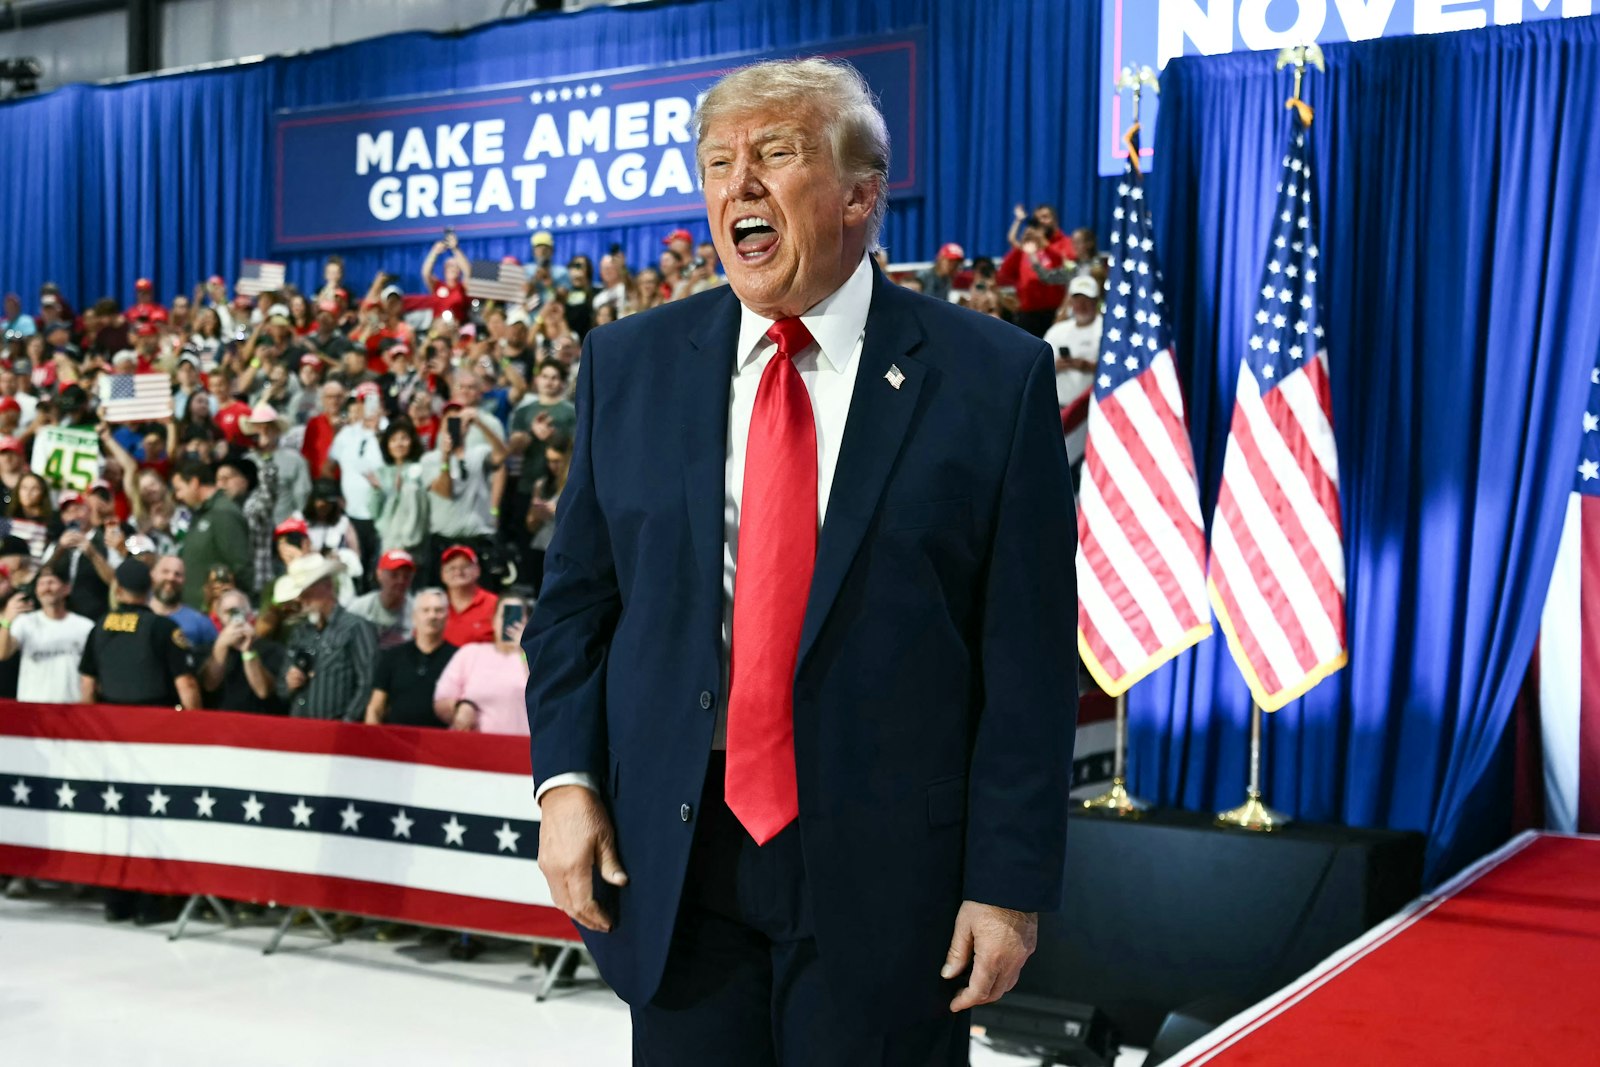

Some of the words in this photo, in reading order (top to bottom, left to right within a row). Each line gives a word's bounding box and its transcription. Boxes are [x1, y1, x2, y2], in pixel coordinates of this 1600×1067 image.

[1157, 0, 1592, 71] NOV
[356, 118, 506, 175] MAKE
[523, 92, 706, 161] AMER
[368, 163, 547, 221] GREAT
[564, 148, 704, 206] AGA
[45, 448, 97, 493] 45
